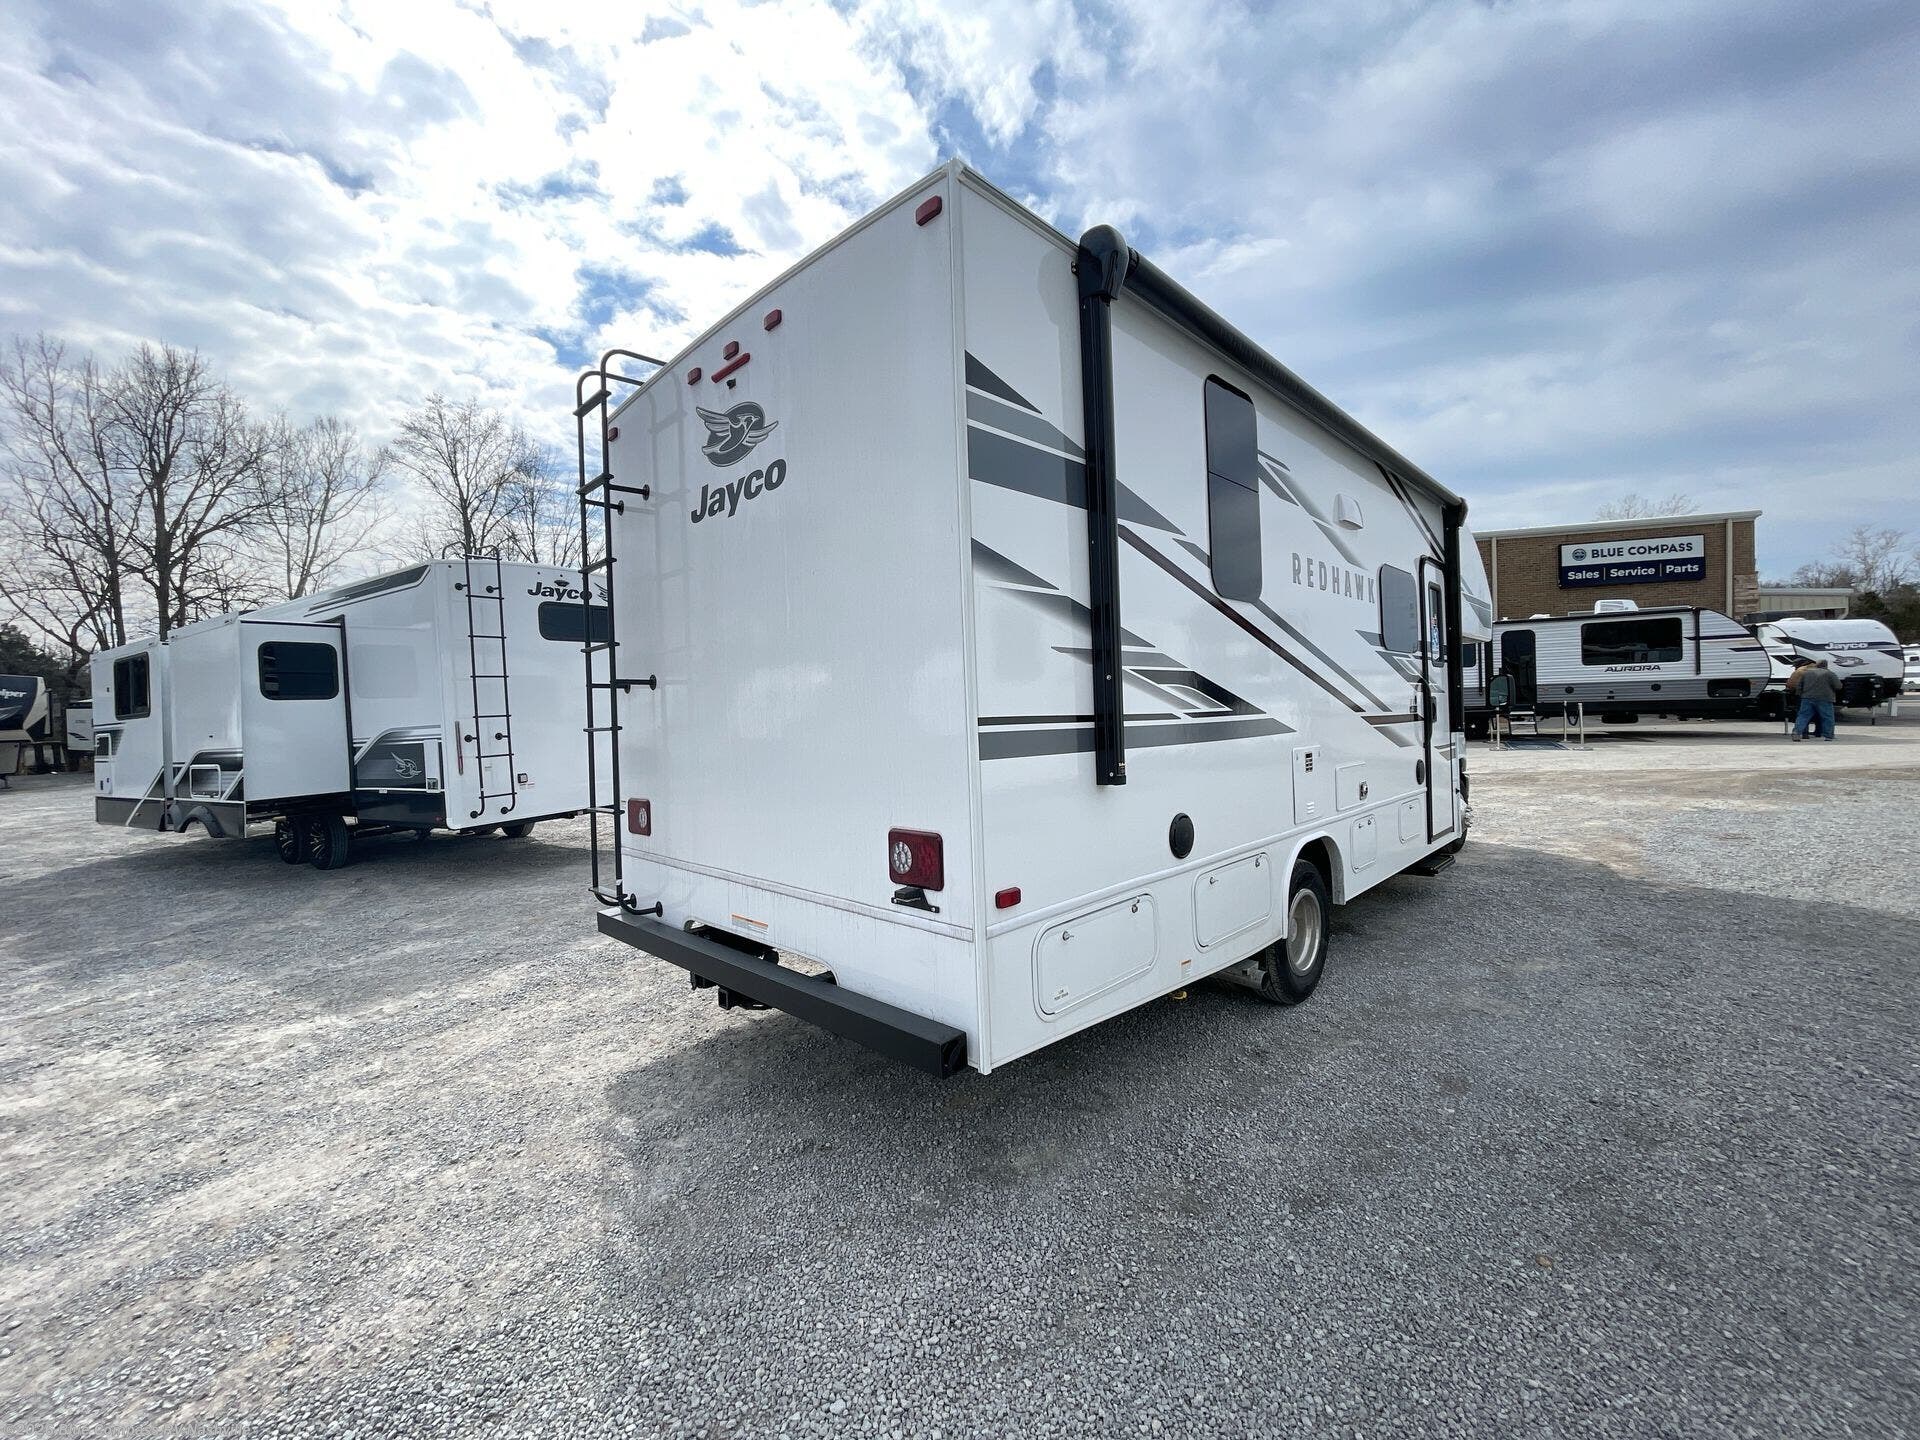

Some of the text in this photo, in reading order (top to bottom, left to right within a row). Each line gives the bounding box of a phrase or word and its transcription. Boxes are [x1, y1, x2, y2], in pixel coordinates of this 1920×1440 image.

[691, 459, 787, 523] Jayco
[1591, 542, 1693, 559] BLUE COMPASS
[1291, 552, 1375, 604] REDHAWK
[1567, 563, 1699, 580] Sales Service Parts
[1824, 642, 1868, 651] Jayco
[1604, 664, 1661, 673] AURORA
